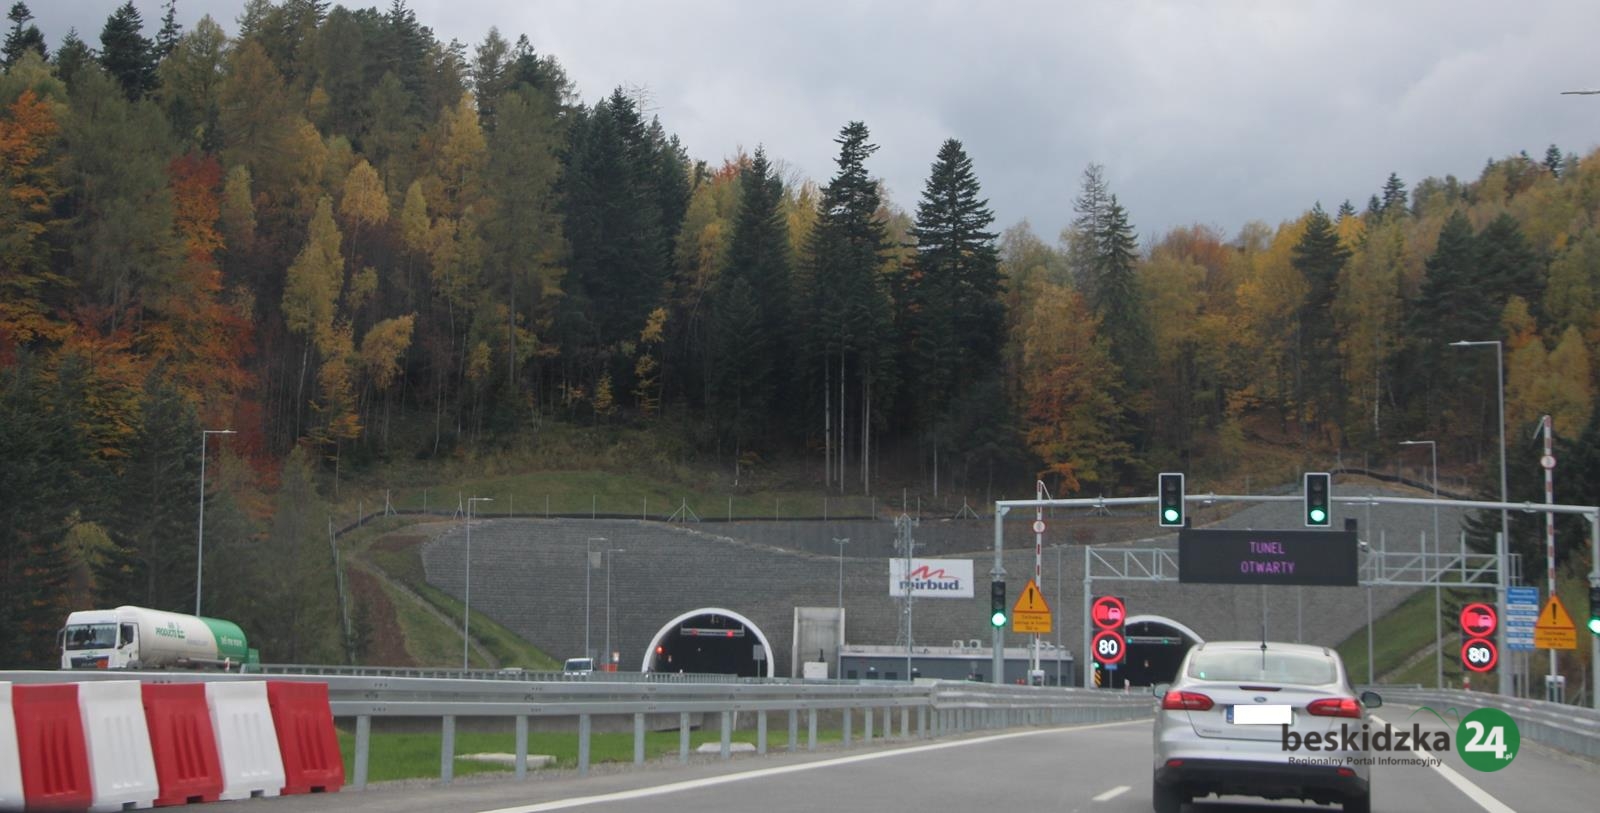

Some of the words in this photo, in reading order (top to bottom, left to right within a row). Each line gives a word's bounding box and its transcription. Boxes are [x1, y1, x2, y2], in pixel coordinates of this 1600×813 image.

[1249, 541, 1285, 554] TUNEL
[1240, 561, 1295, 574] OTWARTY
[1098, 640, 1118, 655] 80
[1468, 647, 1490, 663] 80
